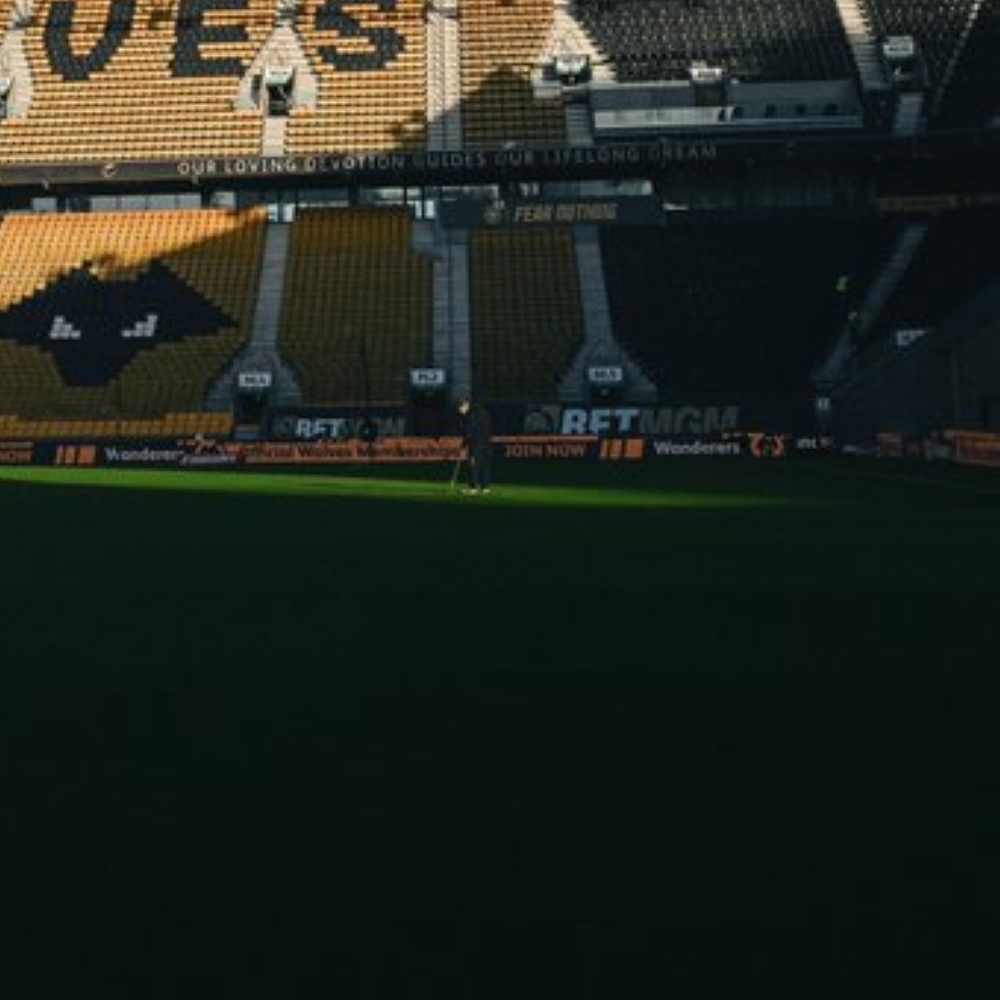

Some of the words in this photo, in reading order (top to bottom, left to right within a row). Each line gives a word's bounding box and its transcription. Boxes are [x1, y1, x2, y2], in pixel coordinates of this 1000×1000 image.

[177, 160, 217, 175] OUR
[226, 157, 297, 174] LOVING
[562, 406, 739, 434] BETMGM
